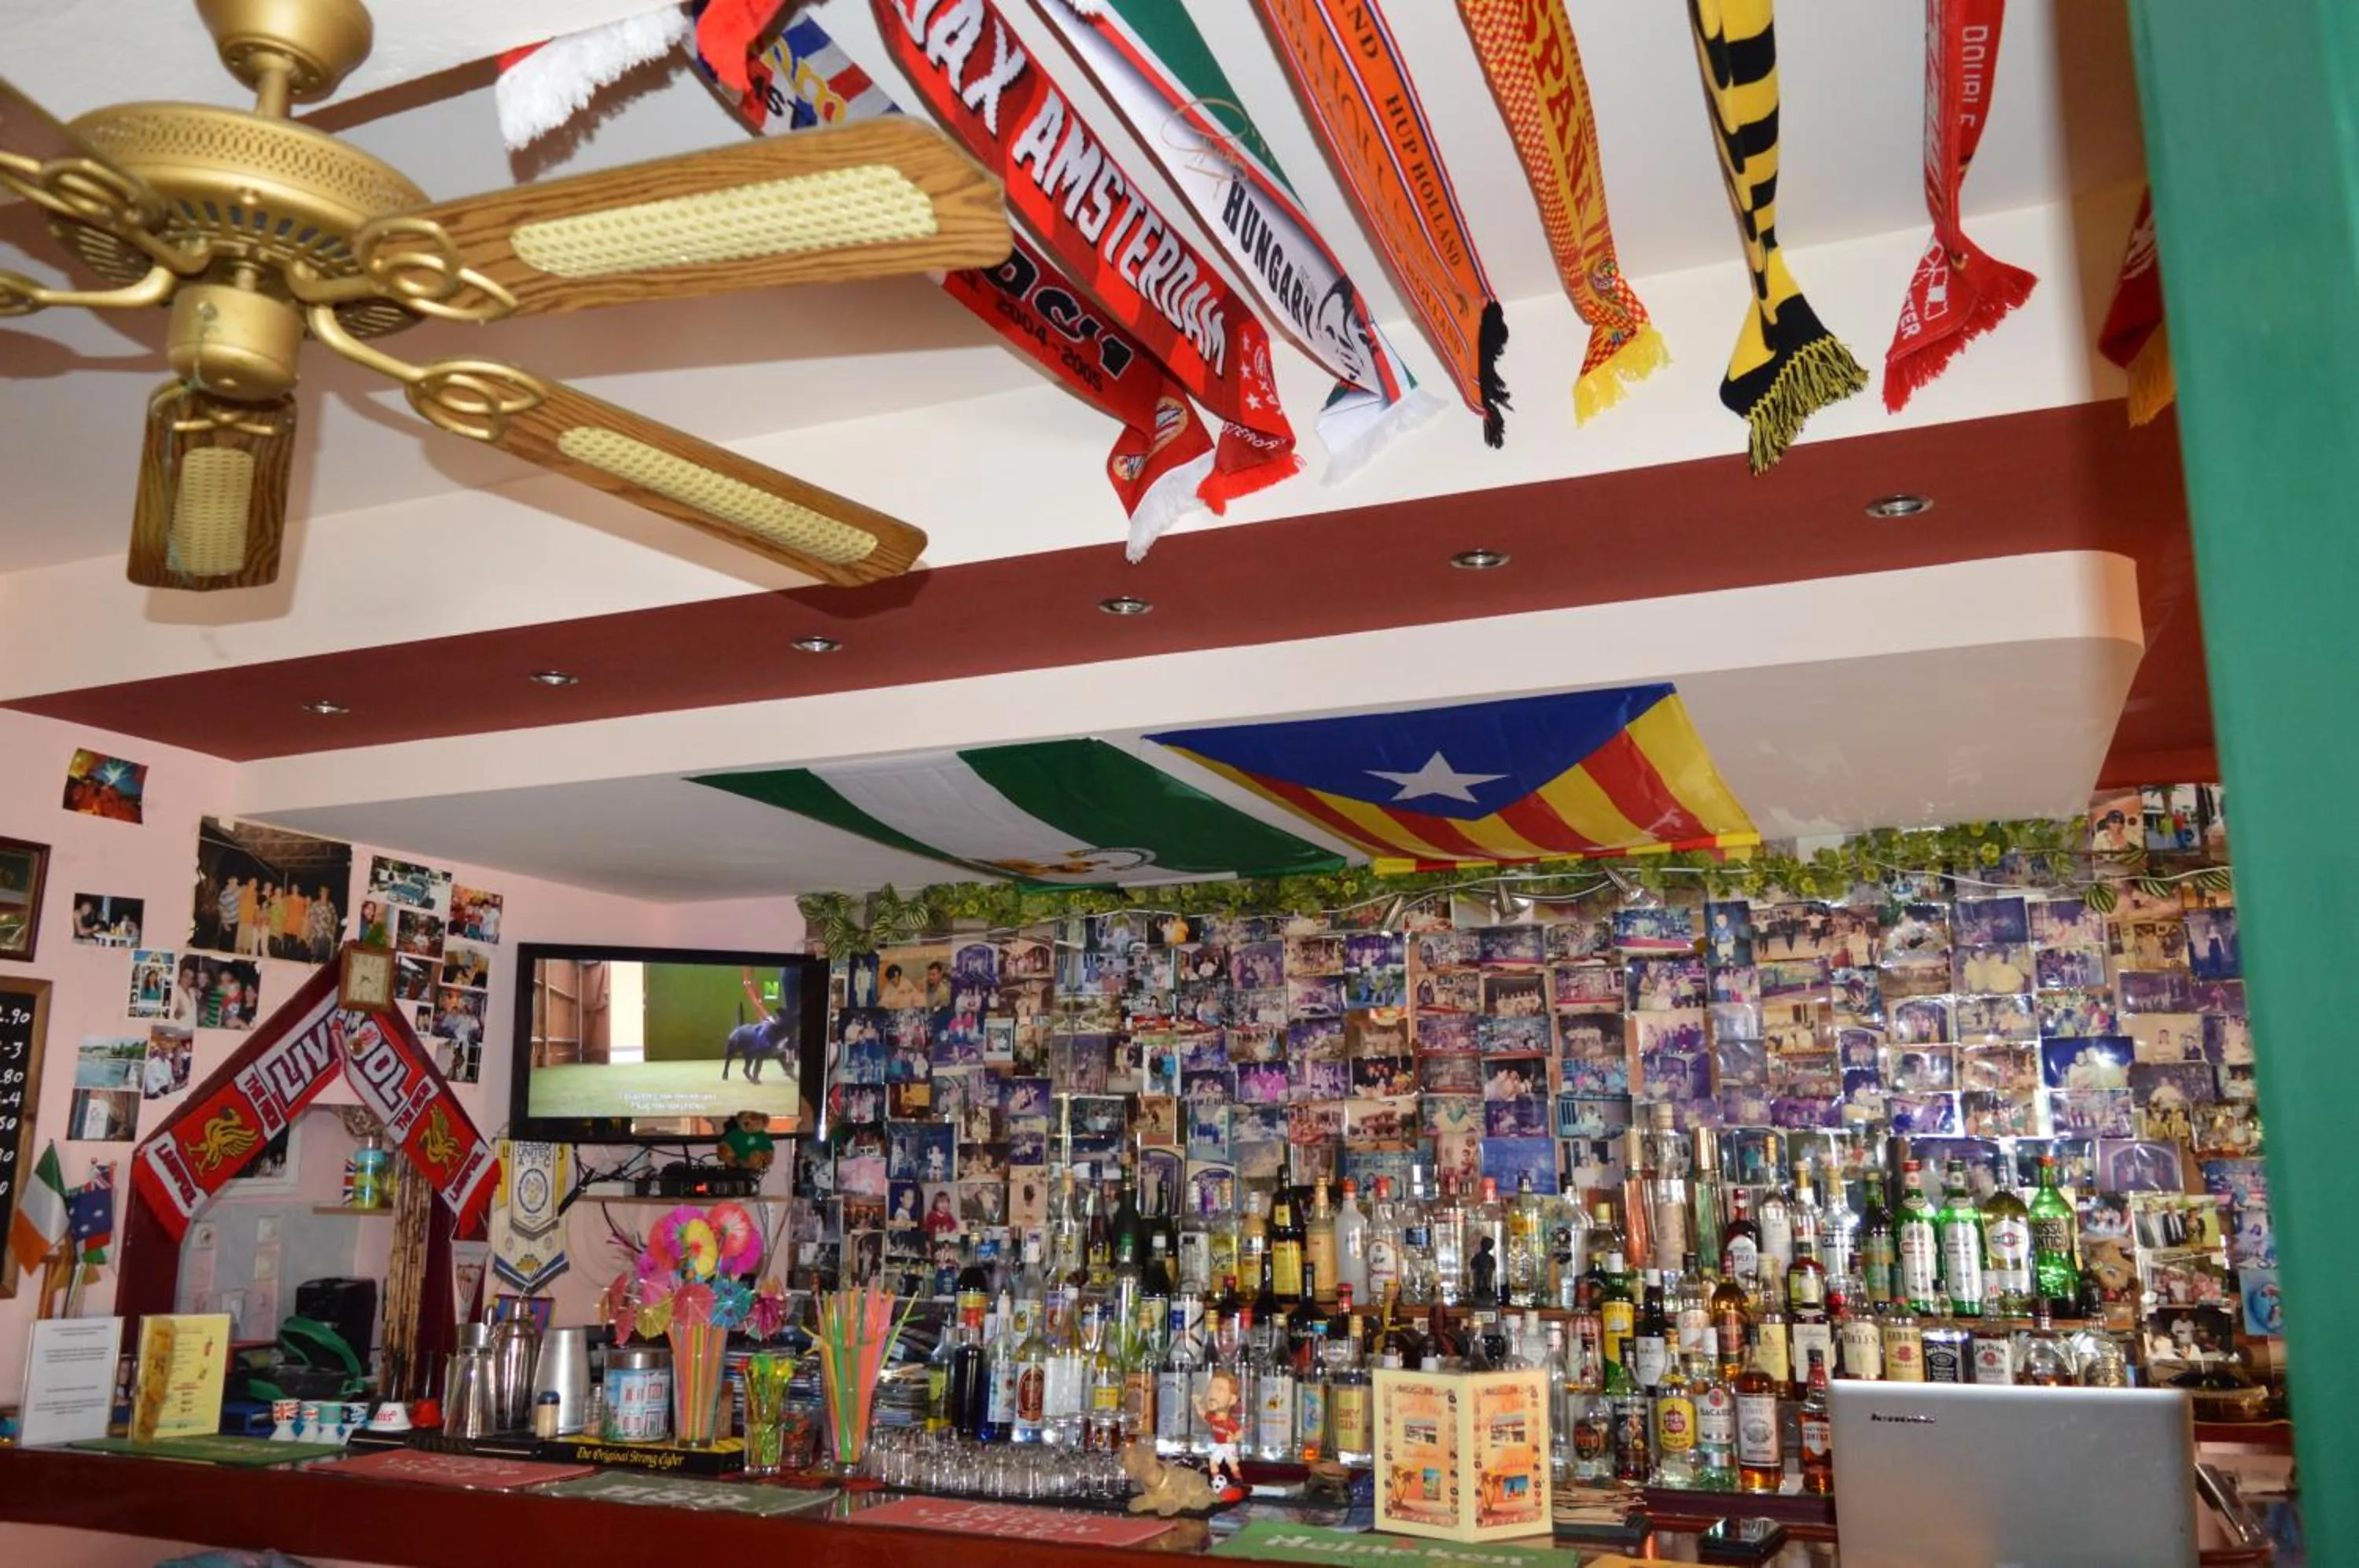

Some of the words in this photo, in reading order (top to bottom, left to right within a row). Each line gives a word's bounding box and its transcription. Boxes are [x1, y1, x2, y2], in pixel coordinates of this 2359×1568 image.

[1012, 85, 1226, 377] AMSTERDAM
[1222, 179, 1314, 341] HUNGARY
[1386, 92, 1419, 156] HUP
[1410, 161, 1462, 269] HOLLAND
[995, 299, 1049, 348] 2004
[1061, 348, 1103, 392] 2005
